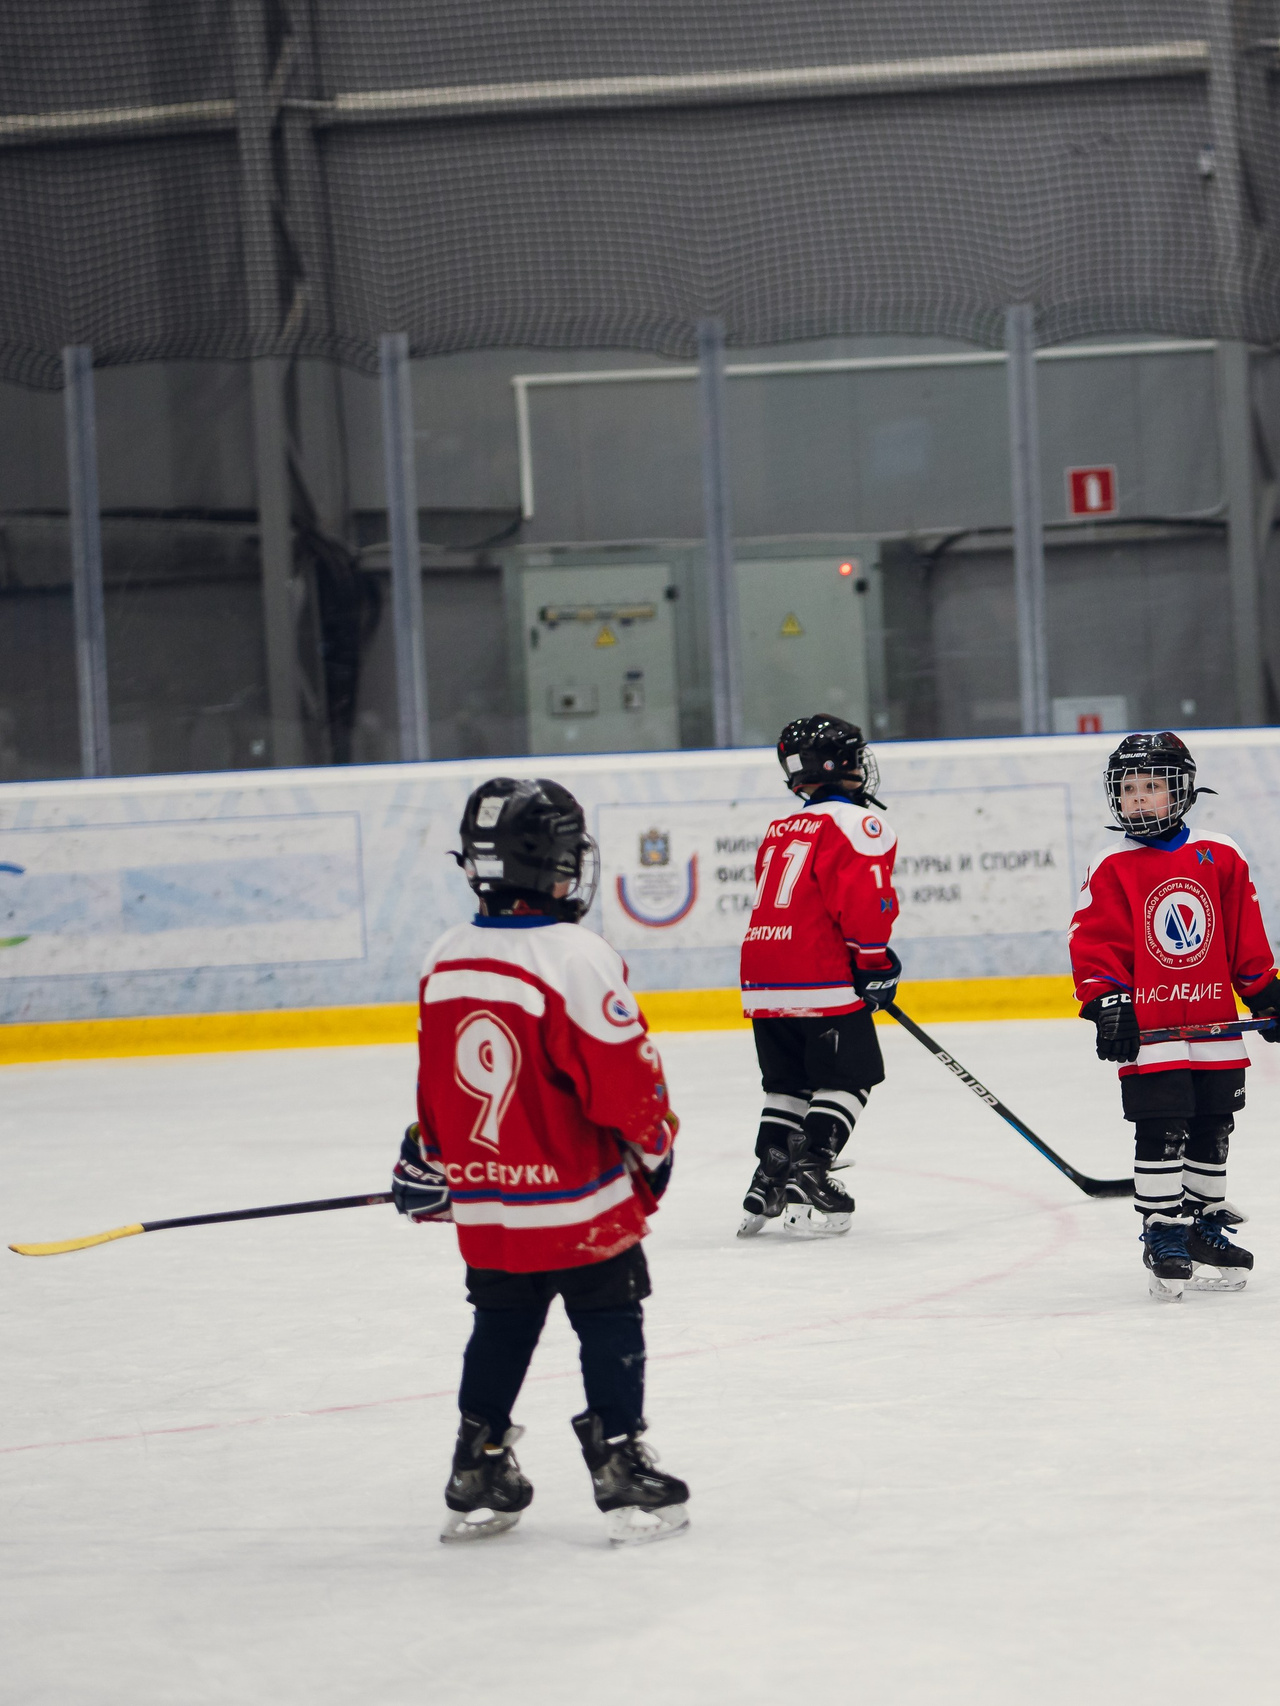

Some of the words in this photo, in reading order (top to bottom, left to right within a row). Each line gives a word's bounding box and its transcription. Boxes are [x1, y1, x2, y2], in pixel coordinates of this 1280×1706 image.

[752, 839, 812, 911] 11
[959, 853, 973, 871] И
[980, 848, 1057, 872] СПОРТА
[1147, 896, 1159, 919] ВИДОВ
[1158, 882, 1183, 897] СПОРТА
[1199, 894, 1212, 928] АВЕРБУХА
[1135, 982, 1223, 1004] НАСЛЕДИЕ
[455, 1008, 522, 1155] 9
